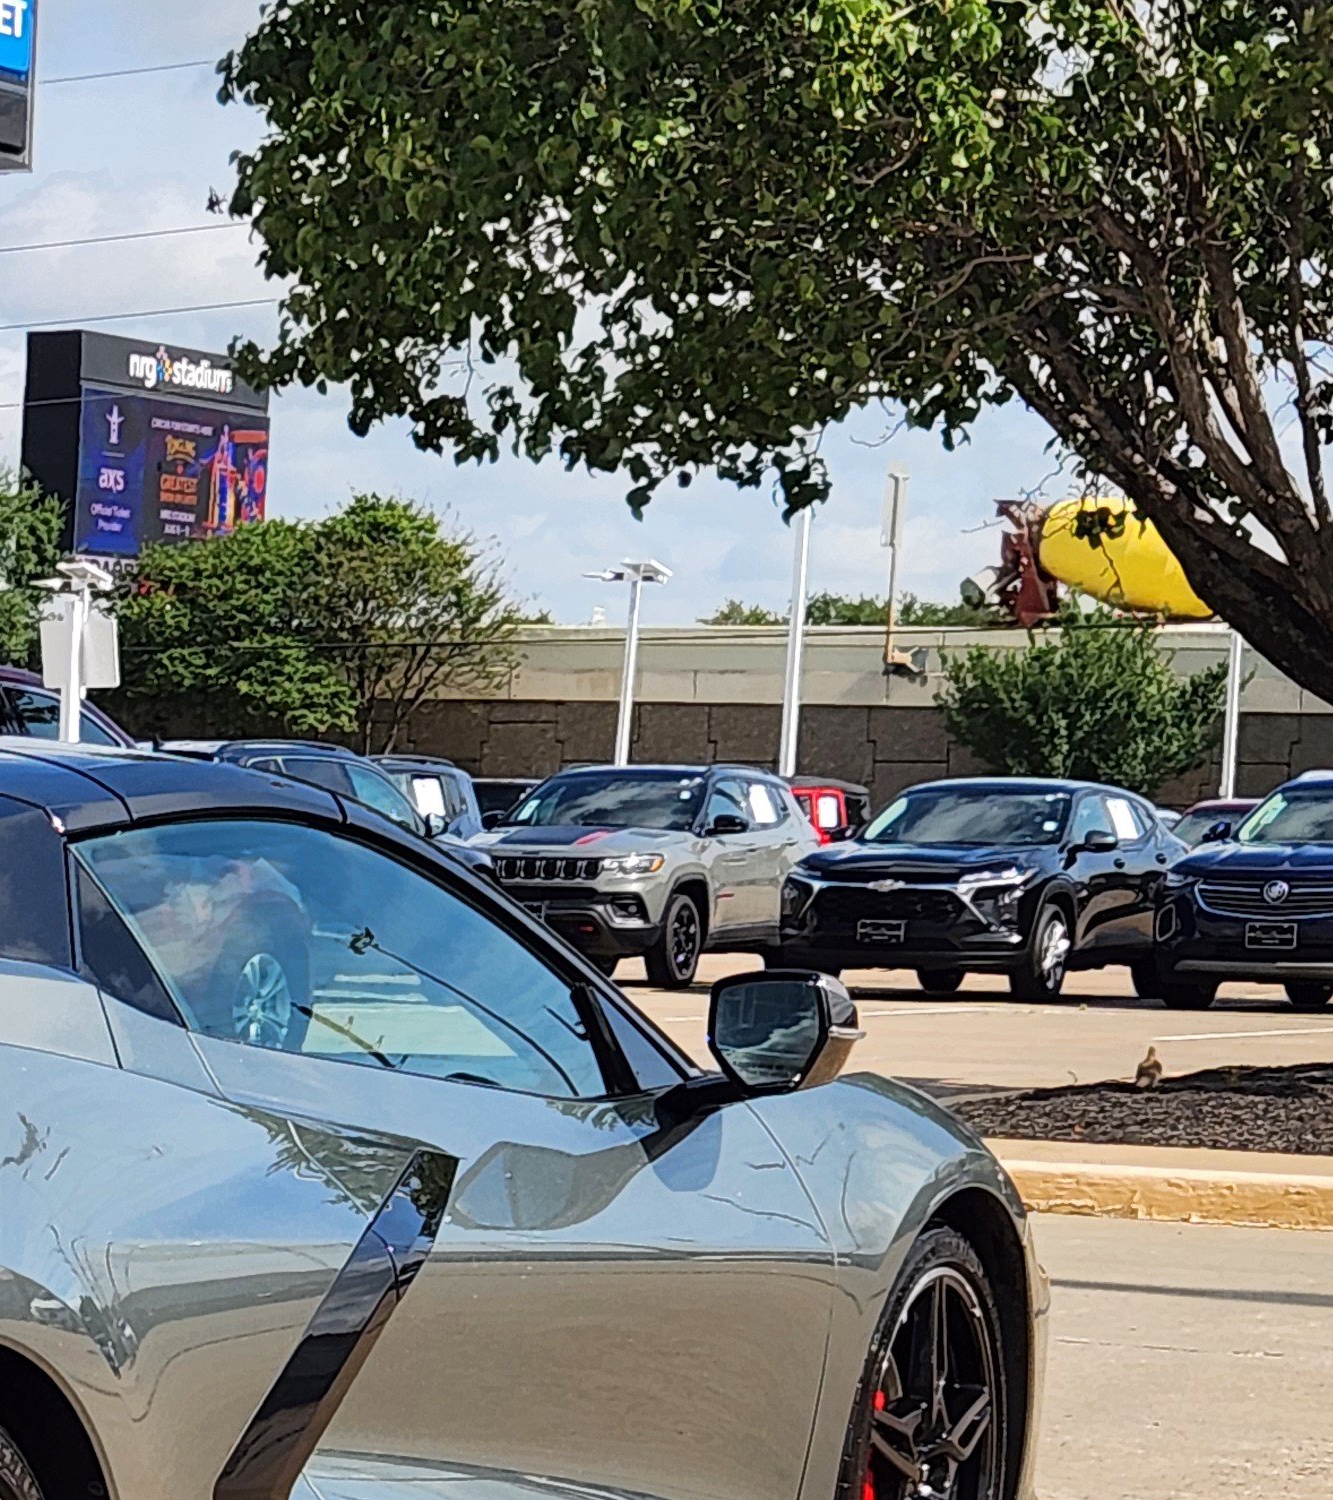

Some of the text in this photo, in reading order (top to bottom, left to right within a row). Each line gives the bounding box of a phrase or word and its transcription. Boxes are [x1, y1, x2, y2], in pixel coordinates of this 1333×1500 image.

[130, 354, 232, 394] nrg stadium
[99, 467, 125, 493] axs
